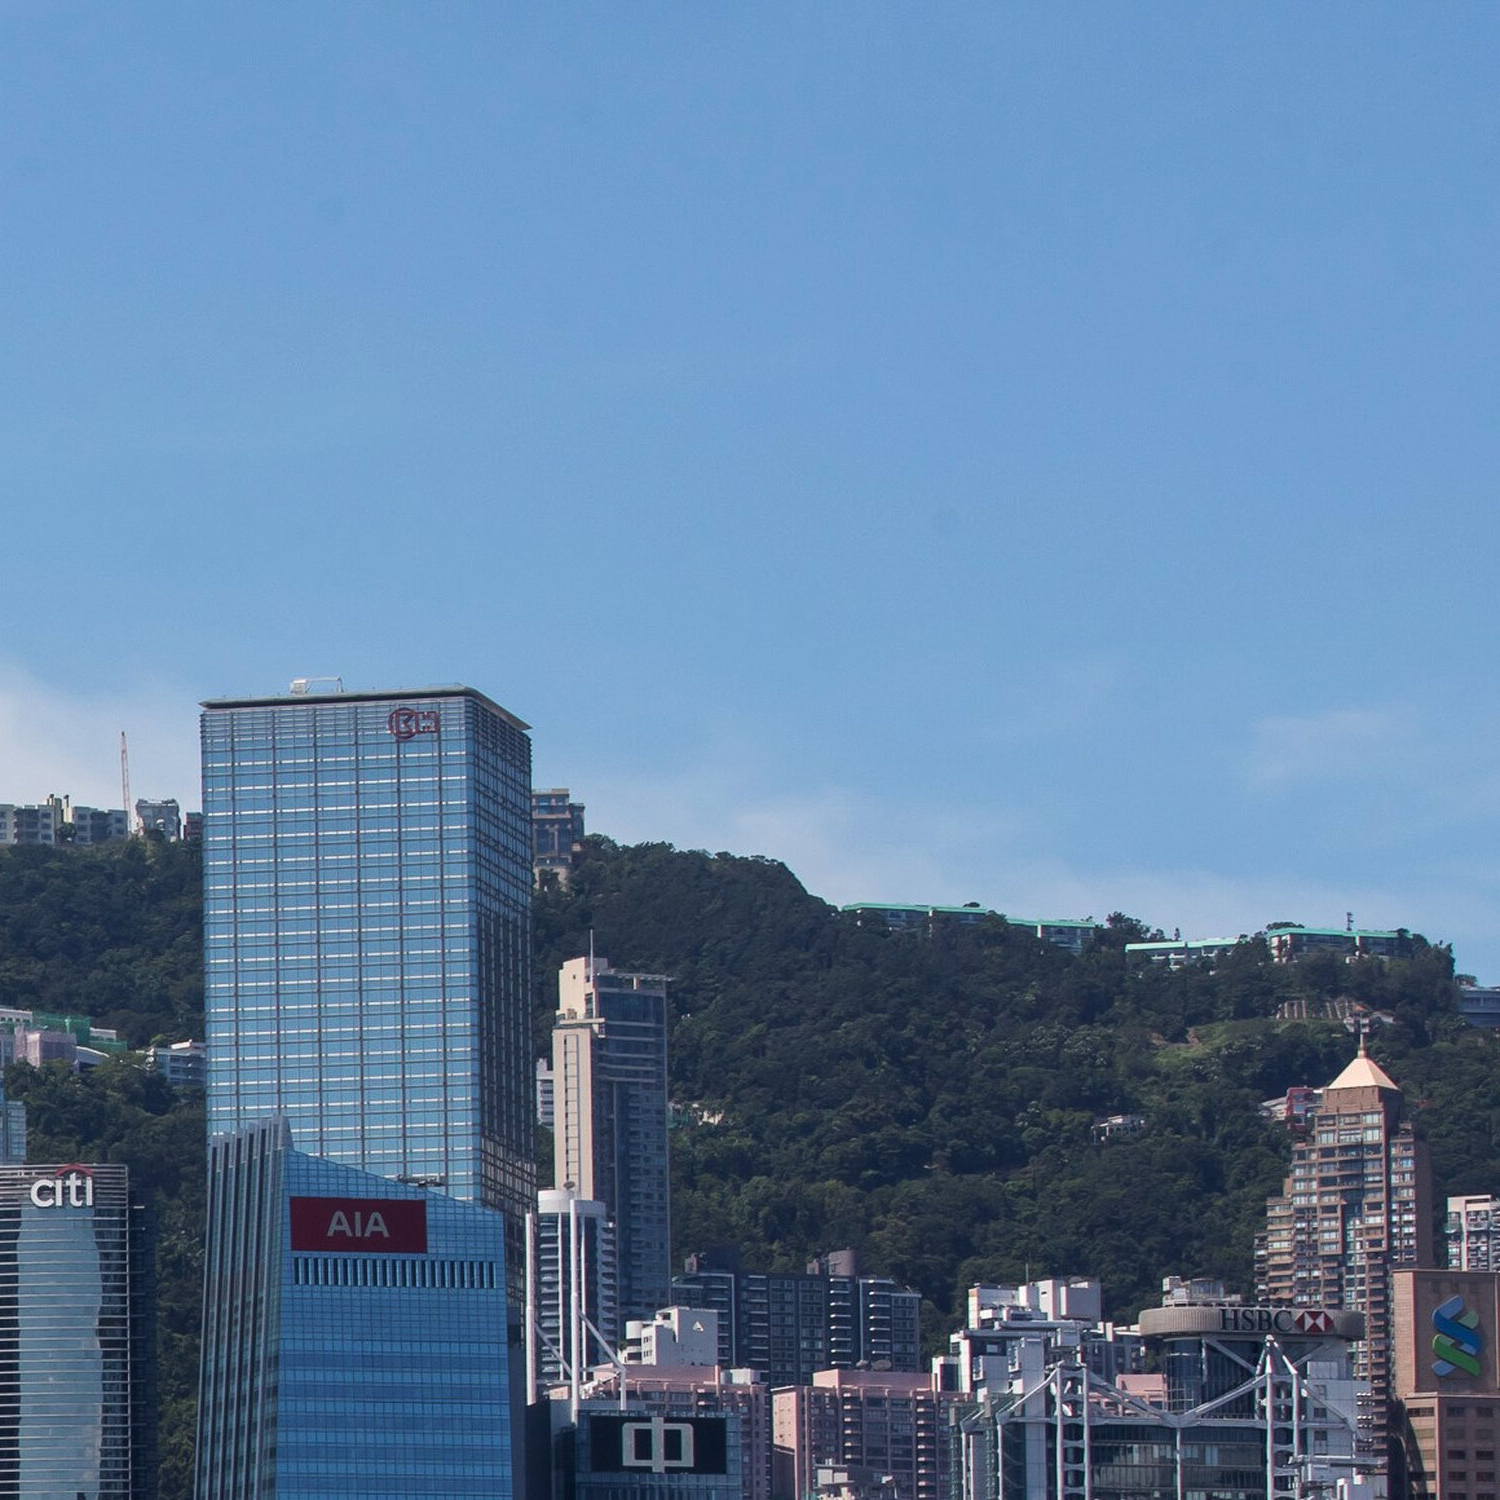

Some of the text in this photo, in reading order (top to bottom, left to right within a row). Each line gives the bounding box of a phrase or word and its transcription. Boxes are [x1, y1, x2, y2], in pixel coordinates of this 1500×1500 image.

[30, 1172, 93, 1207] citi
[327, 1211, 390, 1238] AIA
[1220, 1309, 1293, 1332] HSBC
